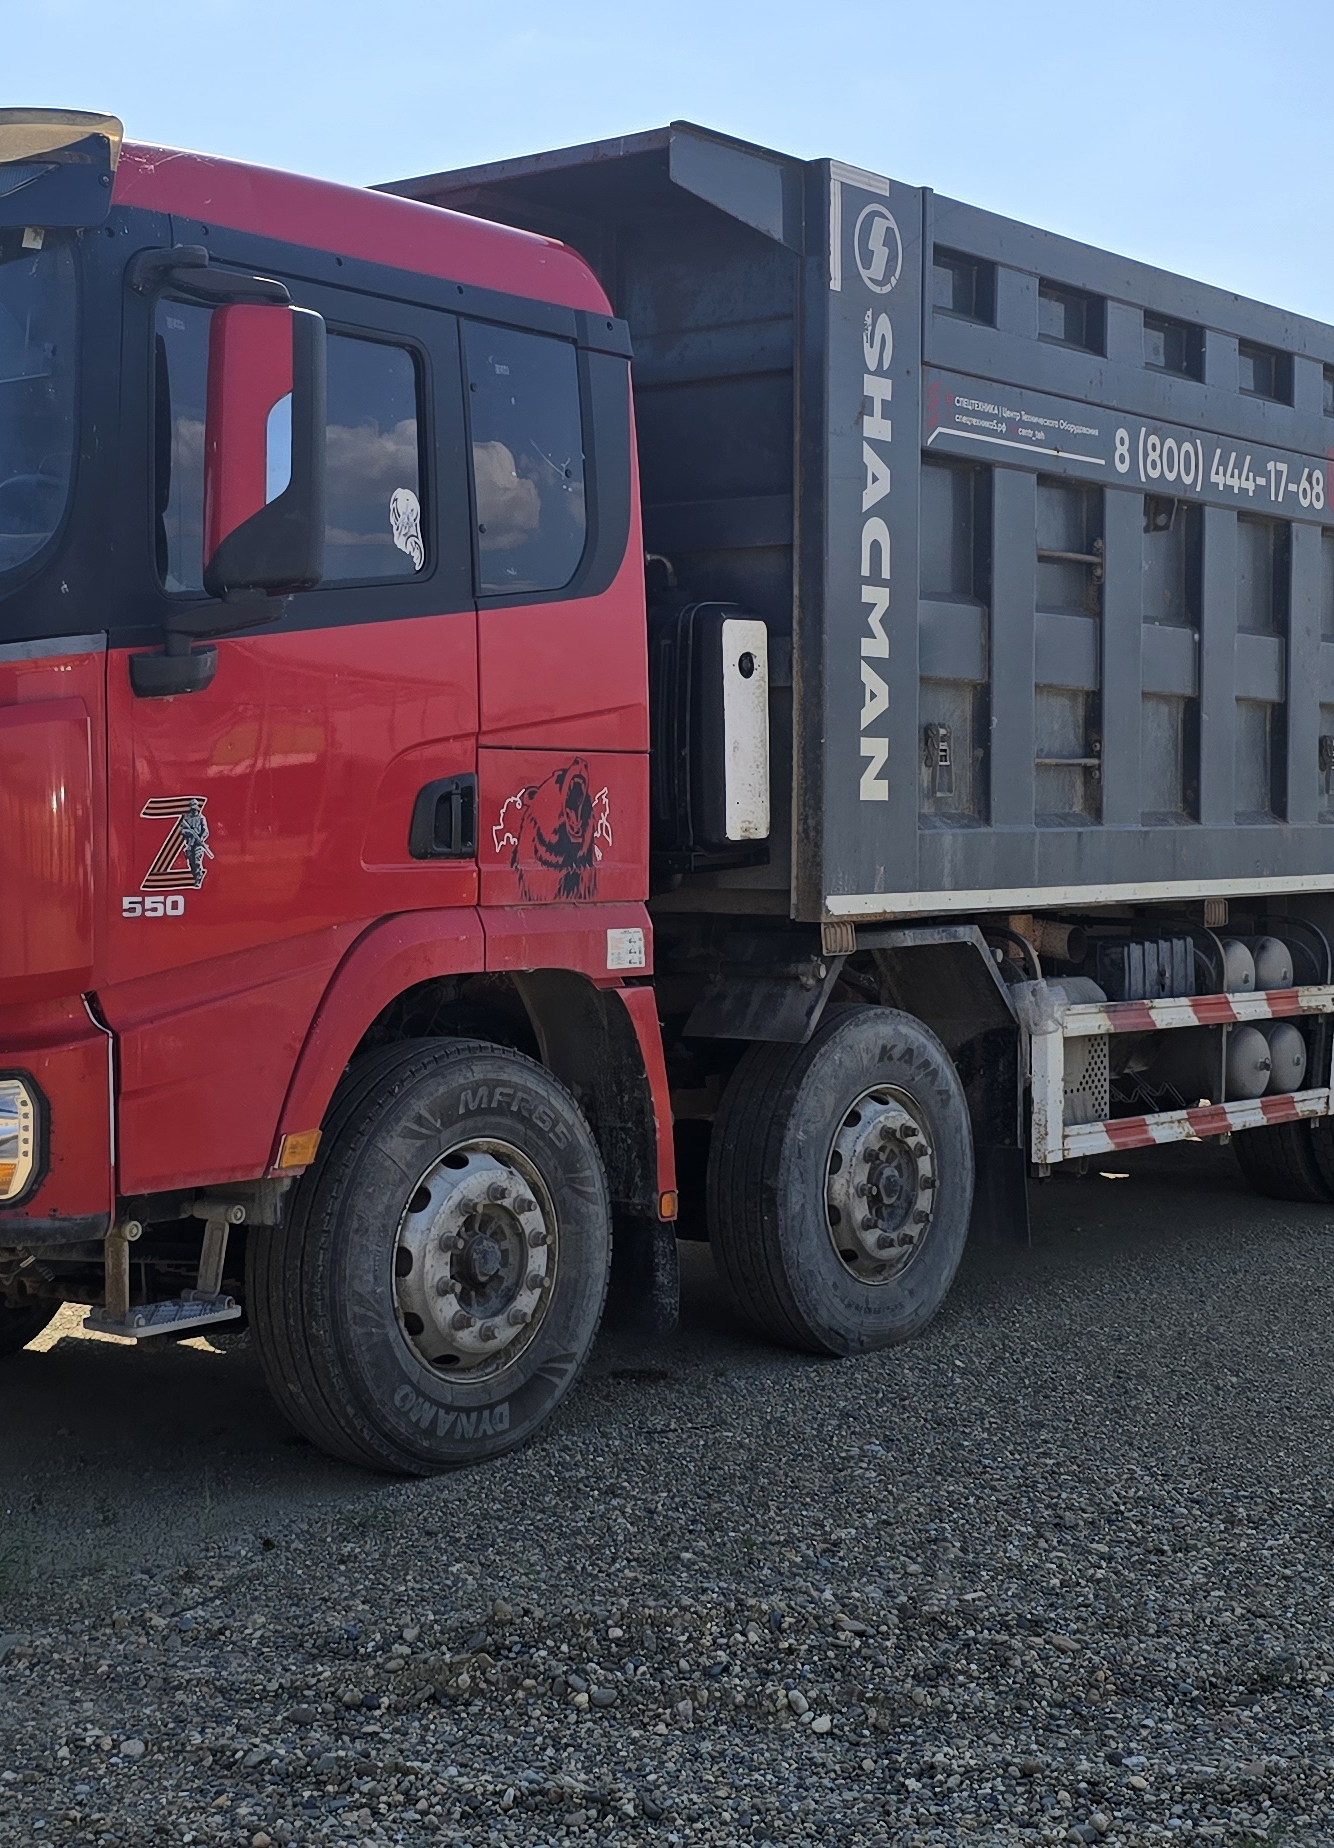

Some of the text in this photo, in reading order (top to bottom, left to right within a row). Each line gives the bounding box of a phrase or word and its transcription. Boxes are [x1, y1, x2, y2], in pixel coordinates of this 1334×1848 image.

[954, 396, 998, 415] СПЕЦТЕХНИКА
[1114, 426, 1325, 510] 8 (800) 444-17-68
[859, 308, 893, 801] SHACMAN
[122, 895, 185, 917] 550
[394, 1384, 510, 1440] DYNAMO
